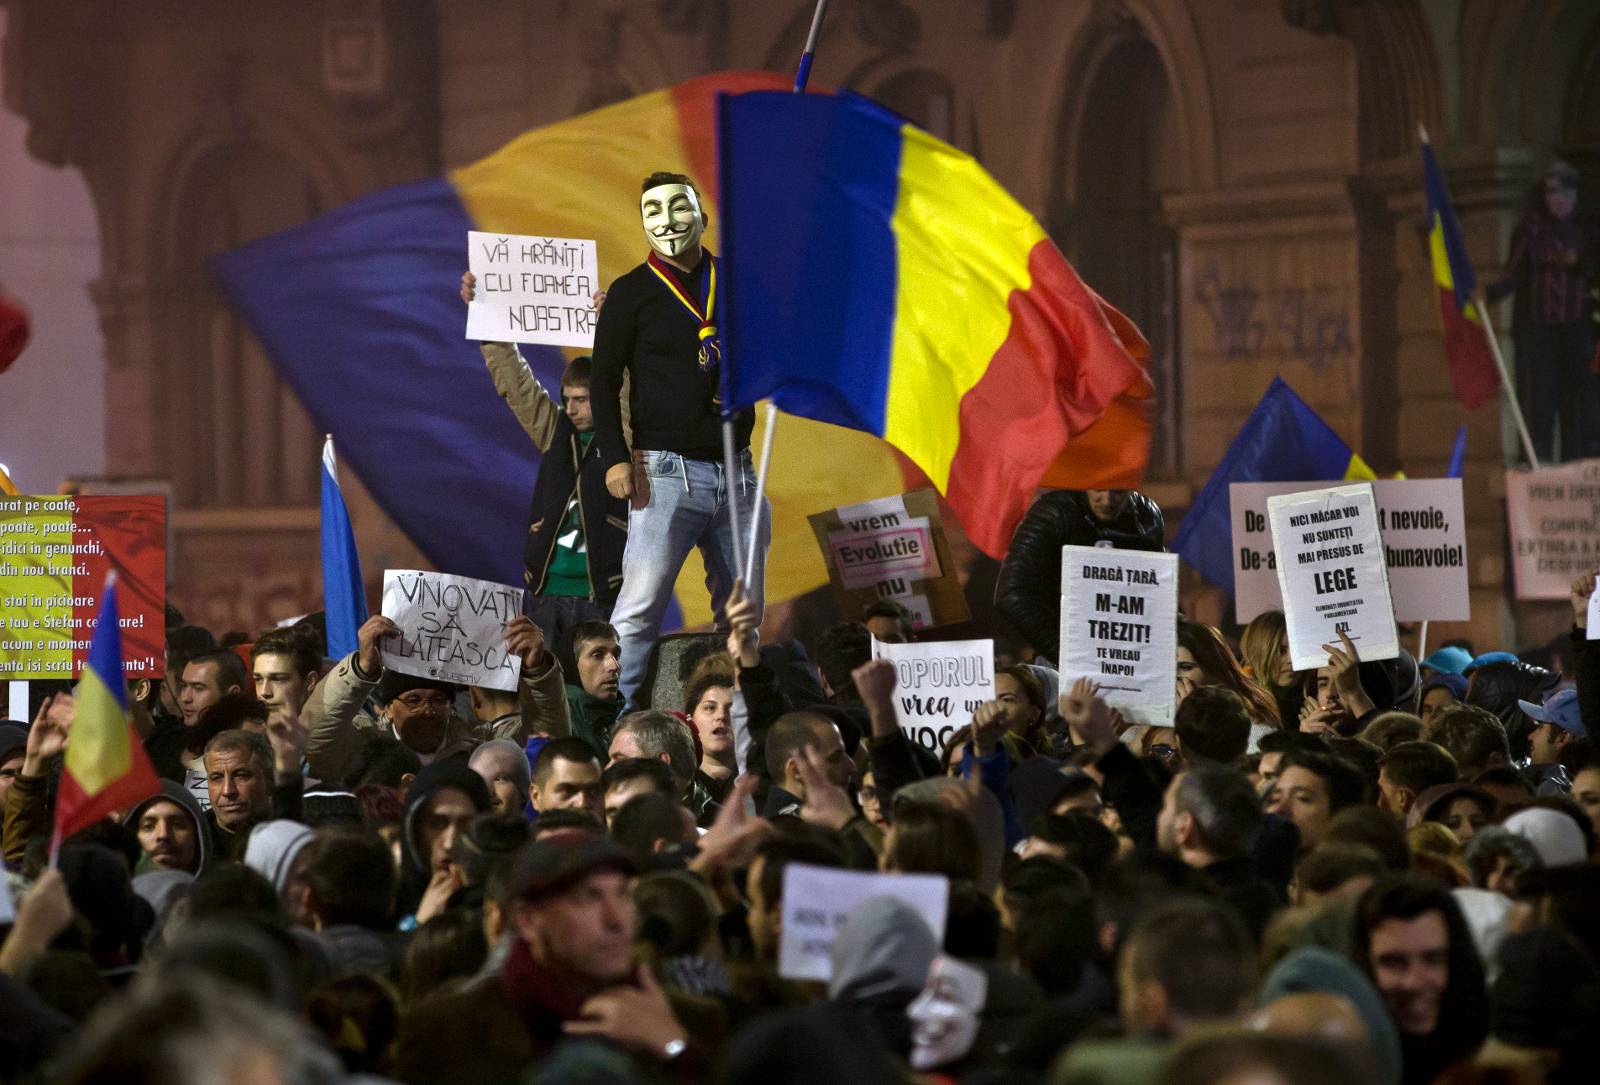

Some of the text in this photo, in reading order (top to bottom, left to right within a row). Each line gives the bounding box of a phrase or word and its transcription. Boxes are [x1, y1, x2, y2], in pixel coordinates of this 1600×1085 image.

[482, 237, 509, 264] VĂ
[484, 273, 592, 298] CU FOAMEA
[509, 304, 598, 335] NOASTRĂ
[25, 502, 40, 515] pe
[43, 500, 80, 514] coate,
[1289, 515, 1310, 528] NICI
[1342, 505, 1360, 519] VOI
[0, 521, 92, 537] poate, poate...
[848, 512, 900, 533] vrem
[1245, 510, 1266, 533] De
[1391, 506, 1449, 533] nevoie,
[0, 540, 104, 558] idici in genunchi,
[1302, 532, 1316, 545] NU
[838, 537, 920, 565] Evolutie
[1297, 543, 1365, 565] MAI PRESUS DE
[1385, 545, 1464, 568] bunavoie!
[0, 562, 91, 576] din nou branci.
[877, 577, 906, 597] nu
[1314, 567, 1358, 595] LEGE
[5, 592, 95, 611] stai in picioare
[1095, 593, 1145, 616] M-AM
[10, 616, 29, 629] tau
[33, 619, 41, 629] e
[44, 614, 83, 629] Stefan
[86, 617, 101, 629] ce
[117, 614, 144, 628] are!
[1088, 620, 1151, 643] TREZIT!
[2, 639, 93, 650] acum e momen
[1097, 647, 1141, 661] TE VREAU
[28, 657, 41, 671] isi
[45, 657, 73, 671] scriu
[897, 656, 991, 689] OPORUL
[1101, 662, 1135, 676] ÎNAPOI
[901, 694, 955, 718] vrea
